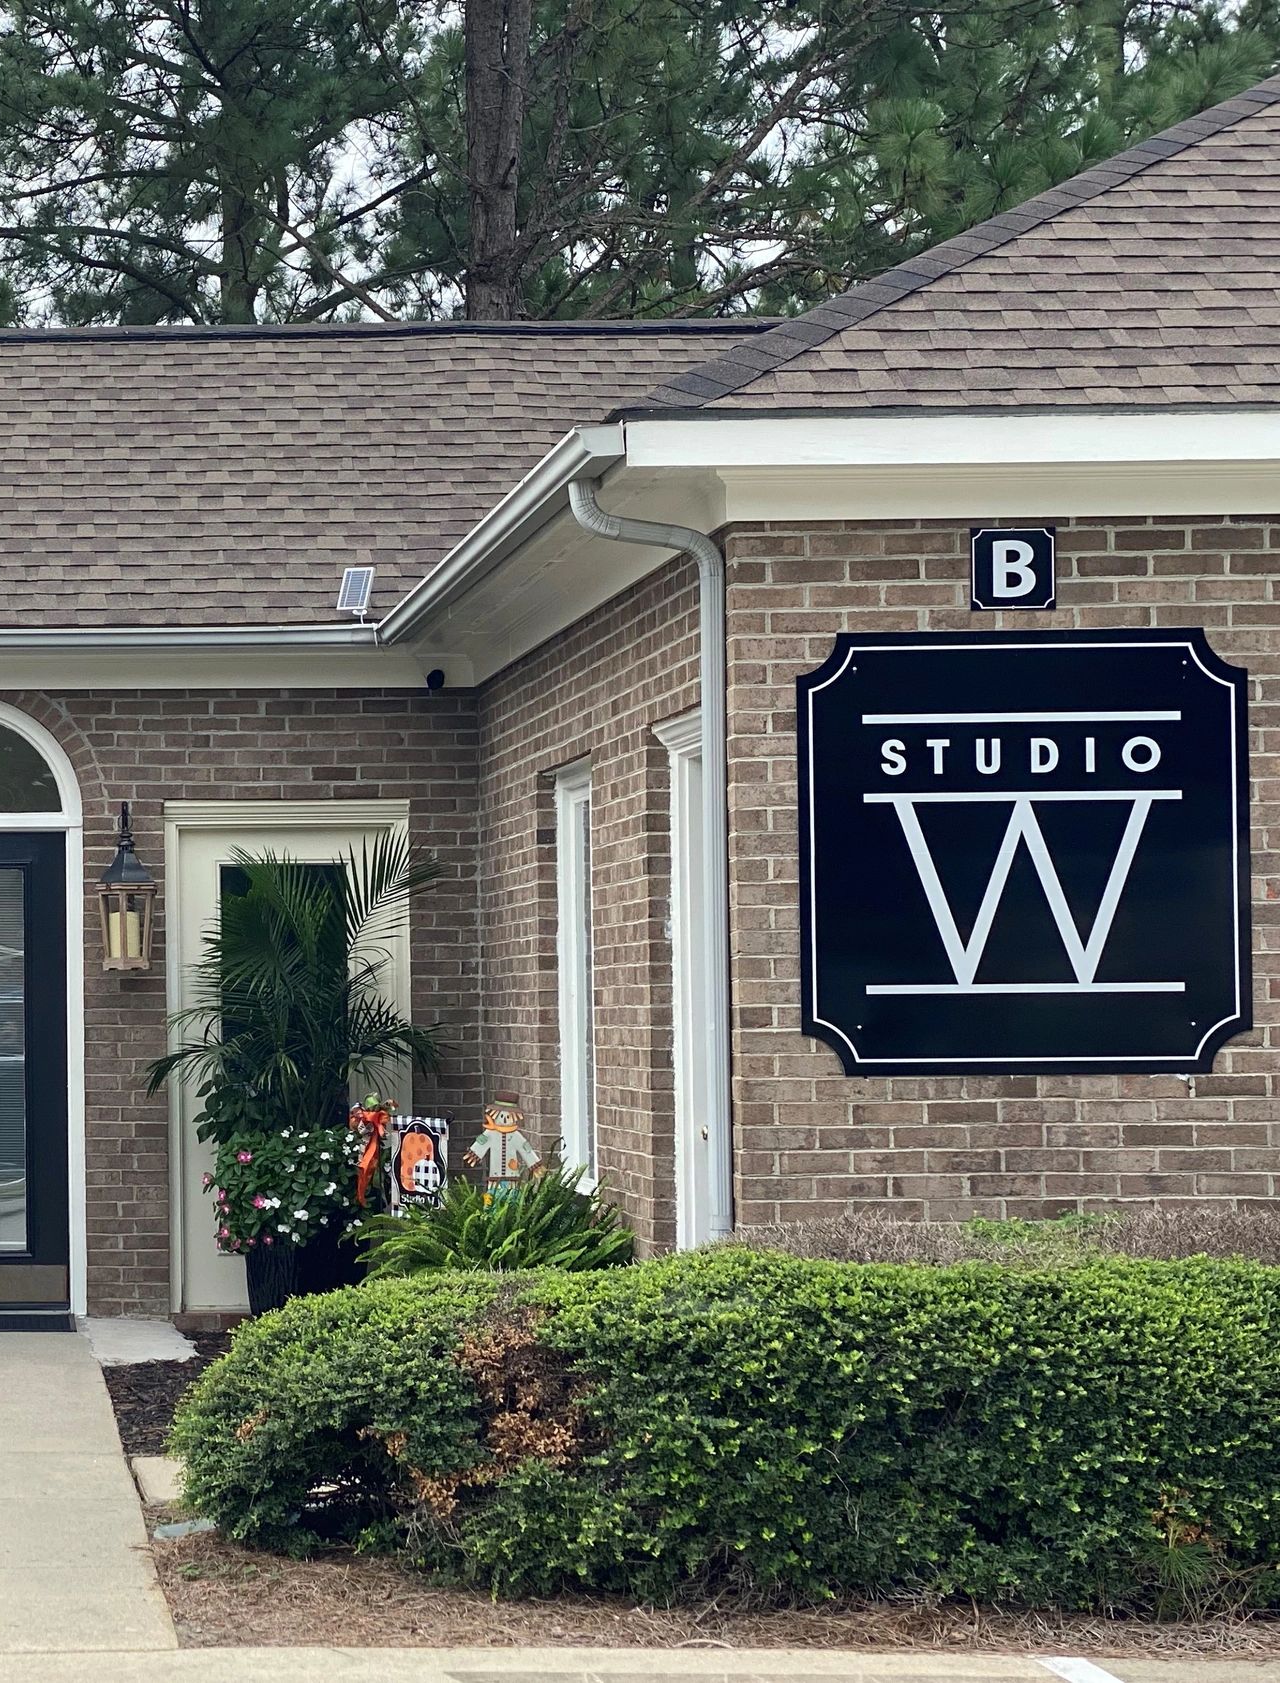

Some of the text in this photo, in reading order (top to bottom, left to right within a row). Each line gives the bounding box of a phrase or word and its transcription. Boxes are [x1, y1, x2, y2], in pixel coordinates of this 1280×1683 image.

[992, 539, 1037, 598] B
[880, 736, 1162, 776] STUDIO
[892, 791, 1153, 993] W
